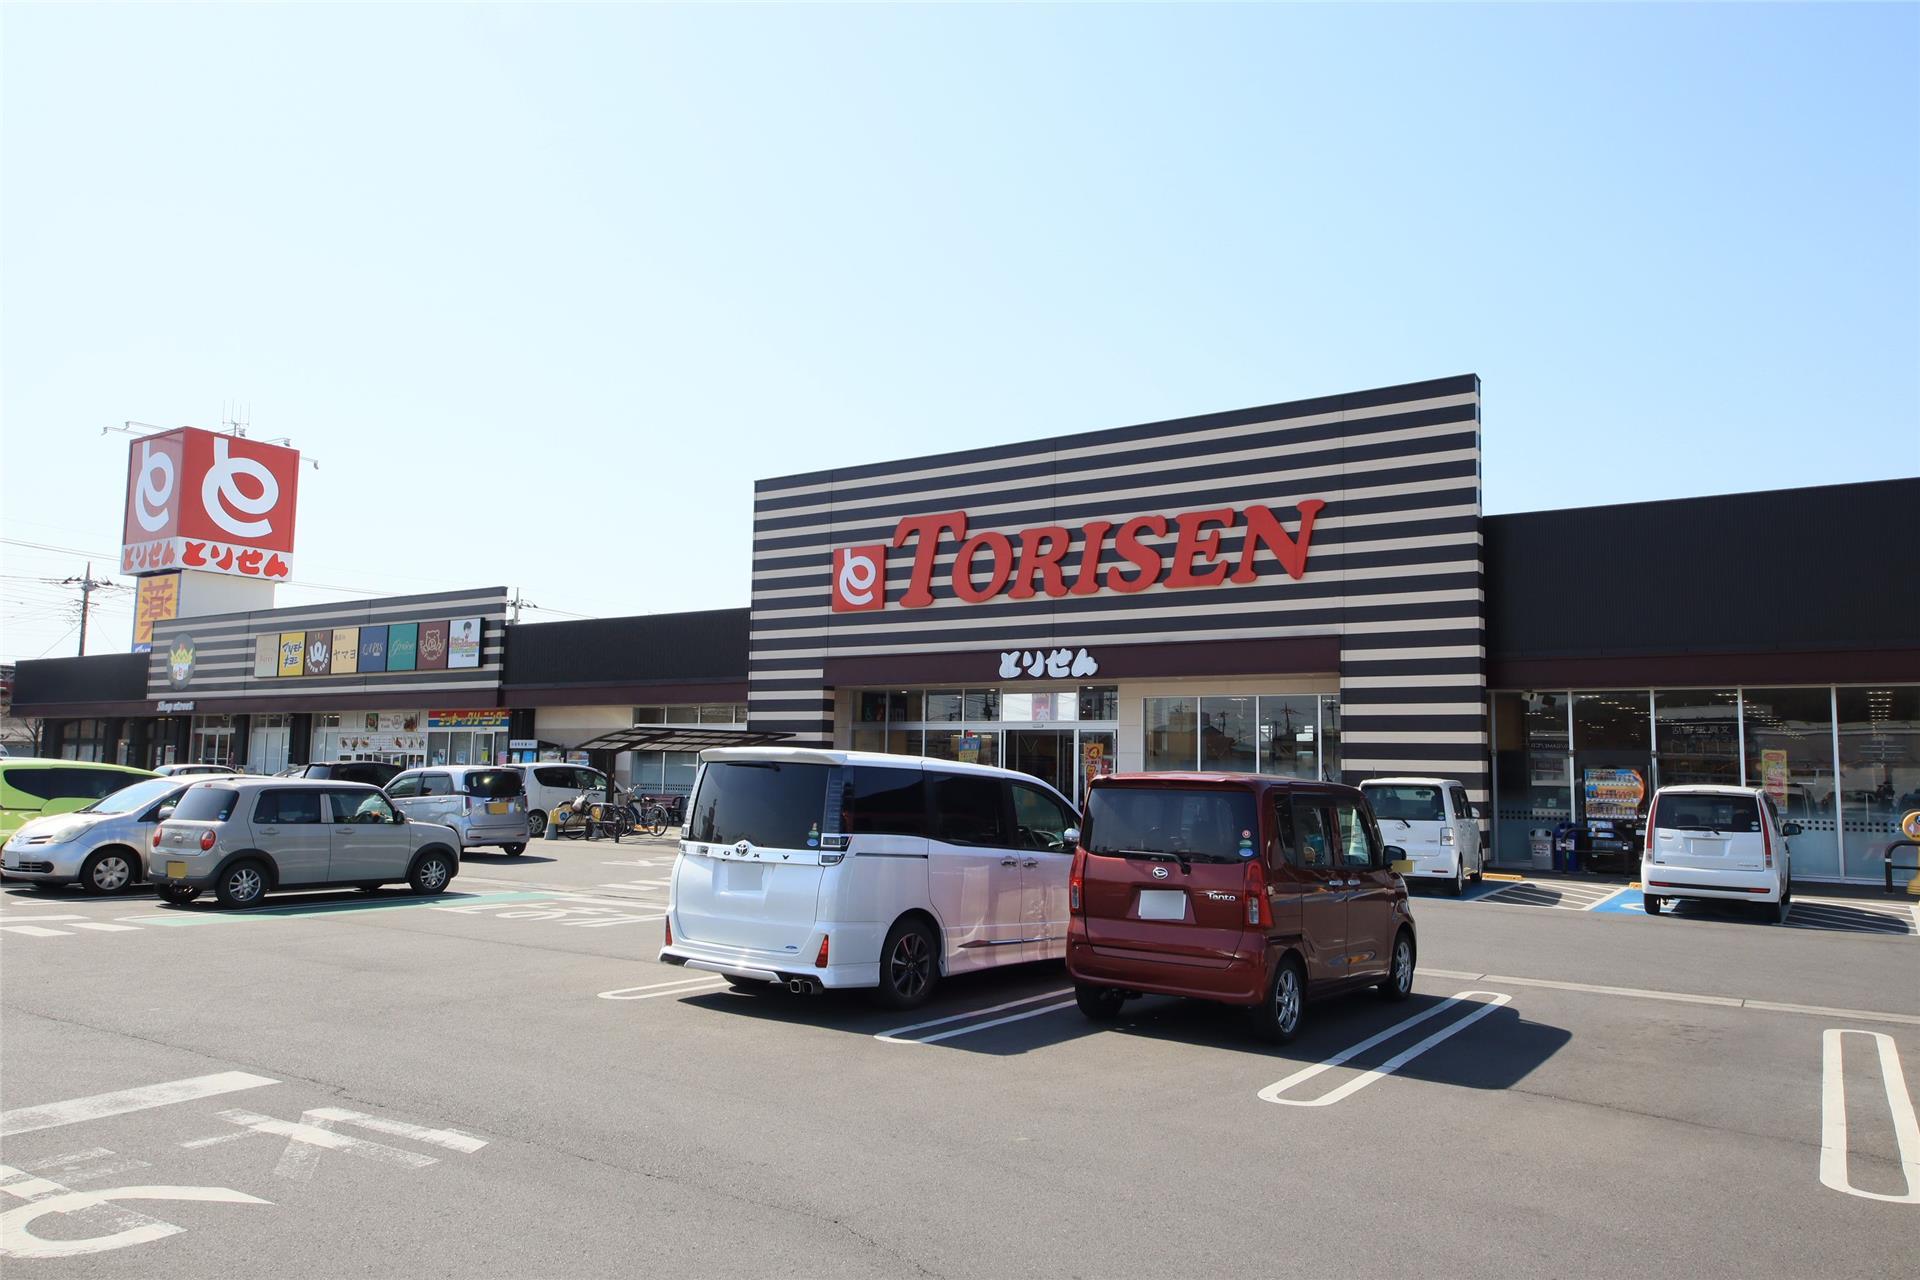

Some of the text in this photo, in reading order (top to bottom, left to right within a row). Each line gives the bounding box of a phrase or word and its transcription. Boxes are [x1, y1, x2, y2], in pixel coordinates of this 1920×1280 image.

[122, 540, 176, 571] とりせん
[182, 541, 289, 578] とりせん
[892, 499, 1327, 608] TORISEN
[998, 647, 1099, 679] とりせん
[1207, 892, 1236, 902] Tanto
